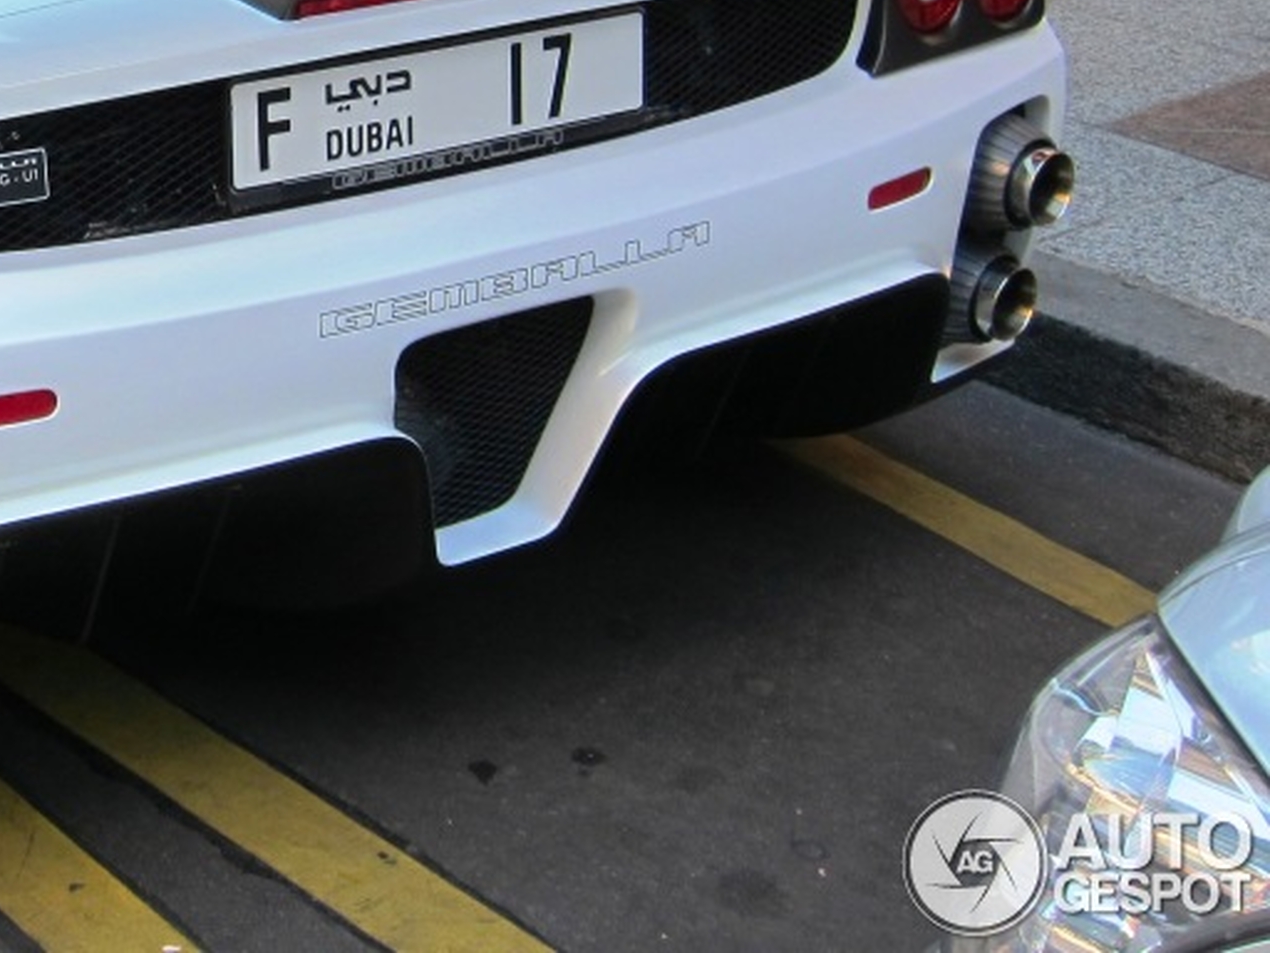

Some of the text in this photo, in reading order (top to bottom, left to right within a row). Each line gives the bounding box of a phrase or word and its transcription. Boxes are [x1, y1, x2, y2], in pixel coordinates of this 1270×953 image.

[324, 69, 412, 113] دبي
[509, 32, 572, 126] 17
[256, 86, 292, 172] F
[326, 115, 414, 162] DUBAI
[319, 221, 710, 338] GEMBALLA
